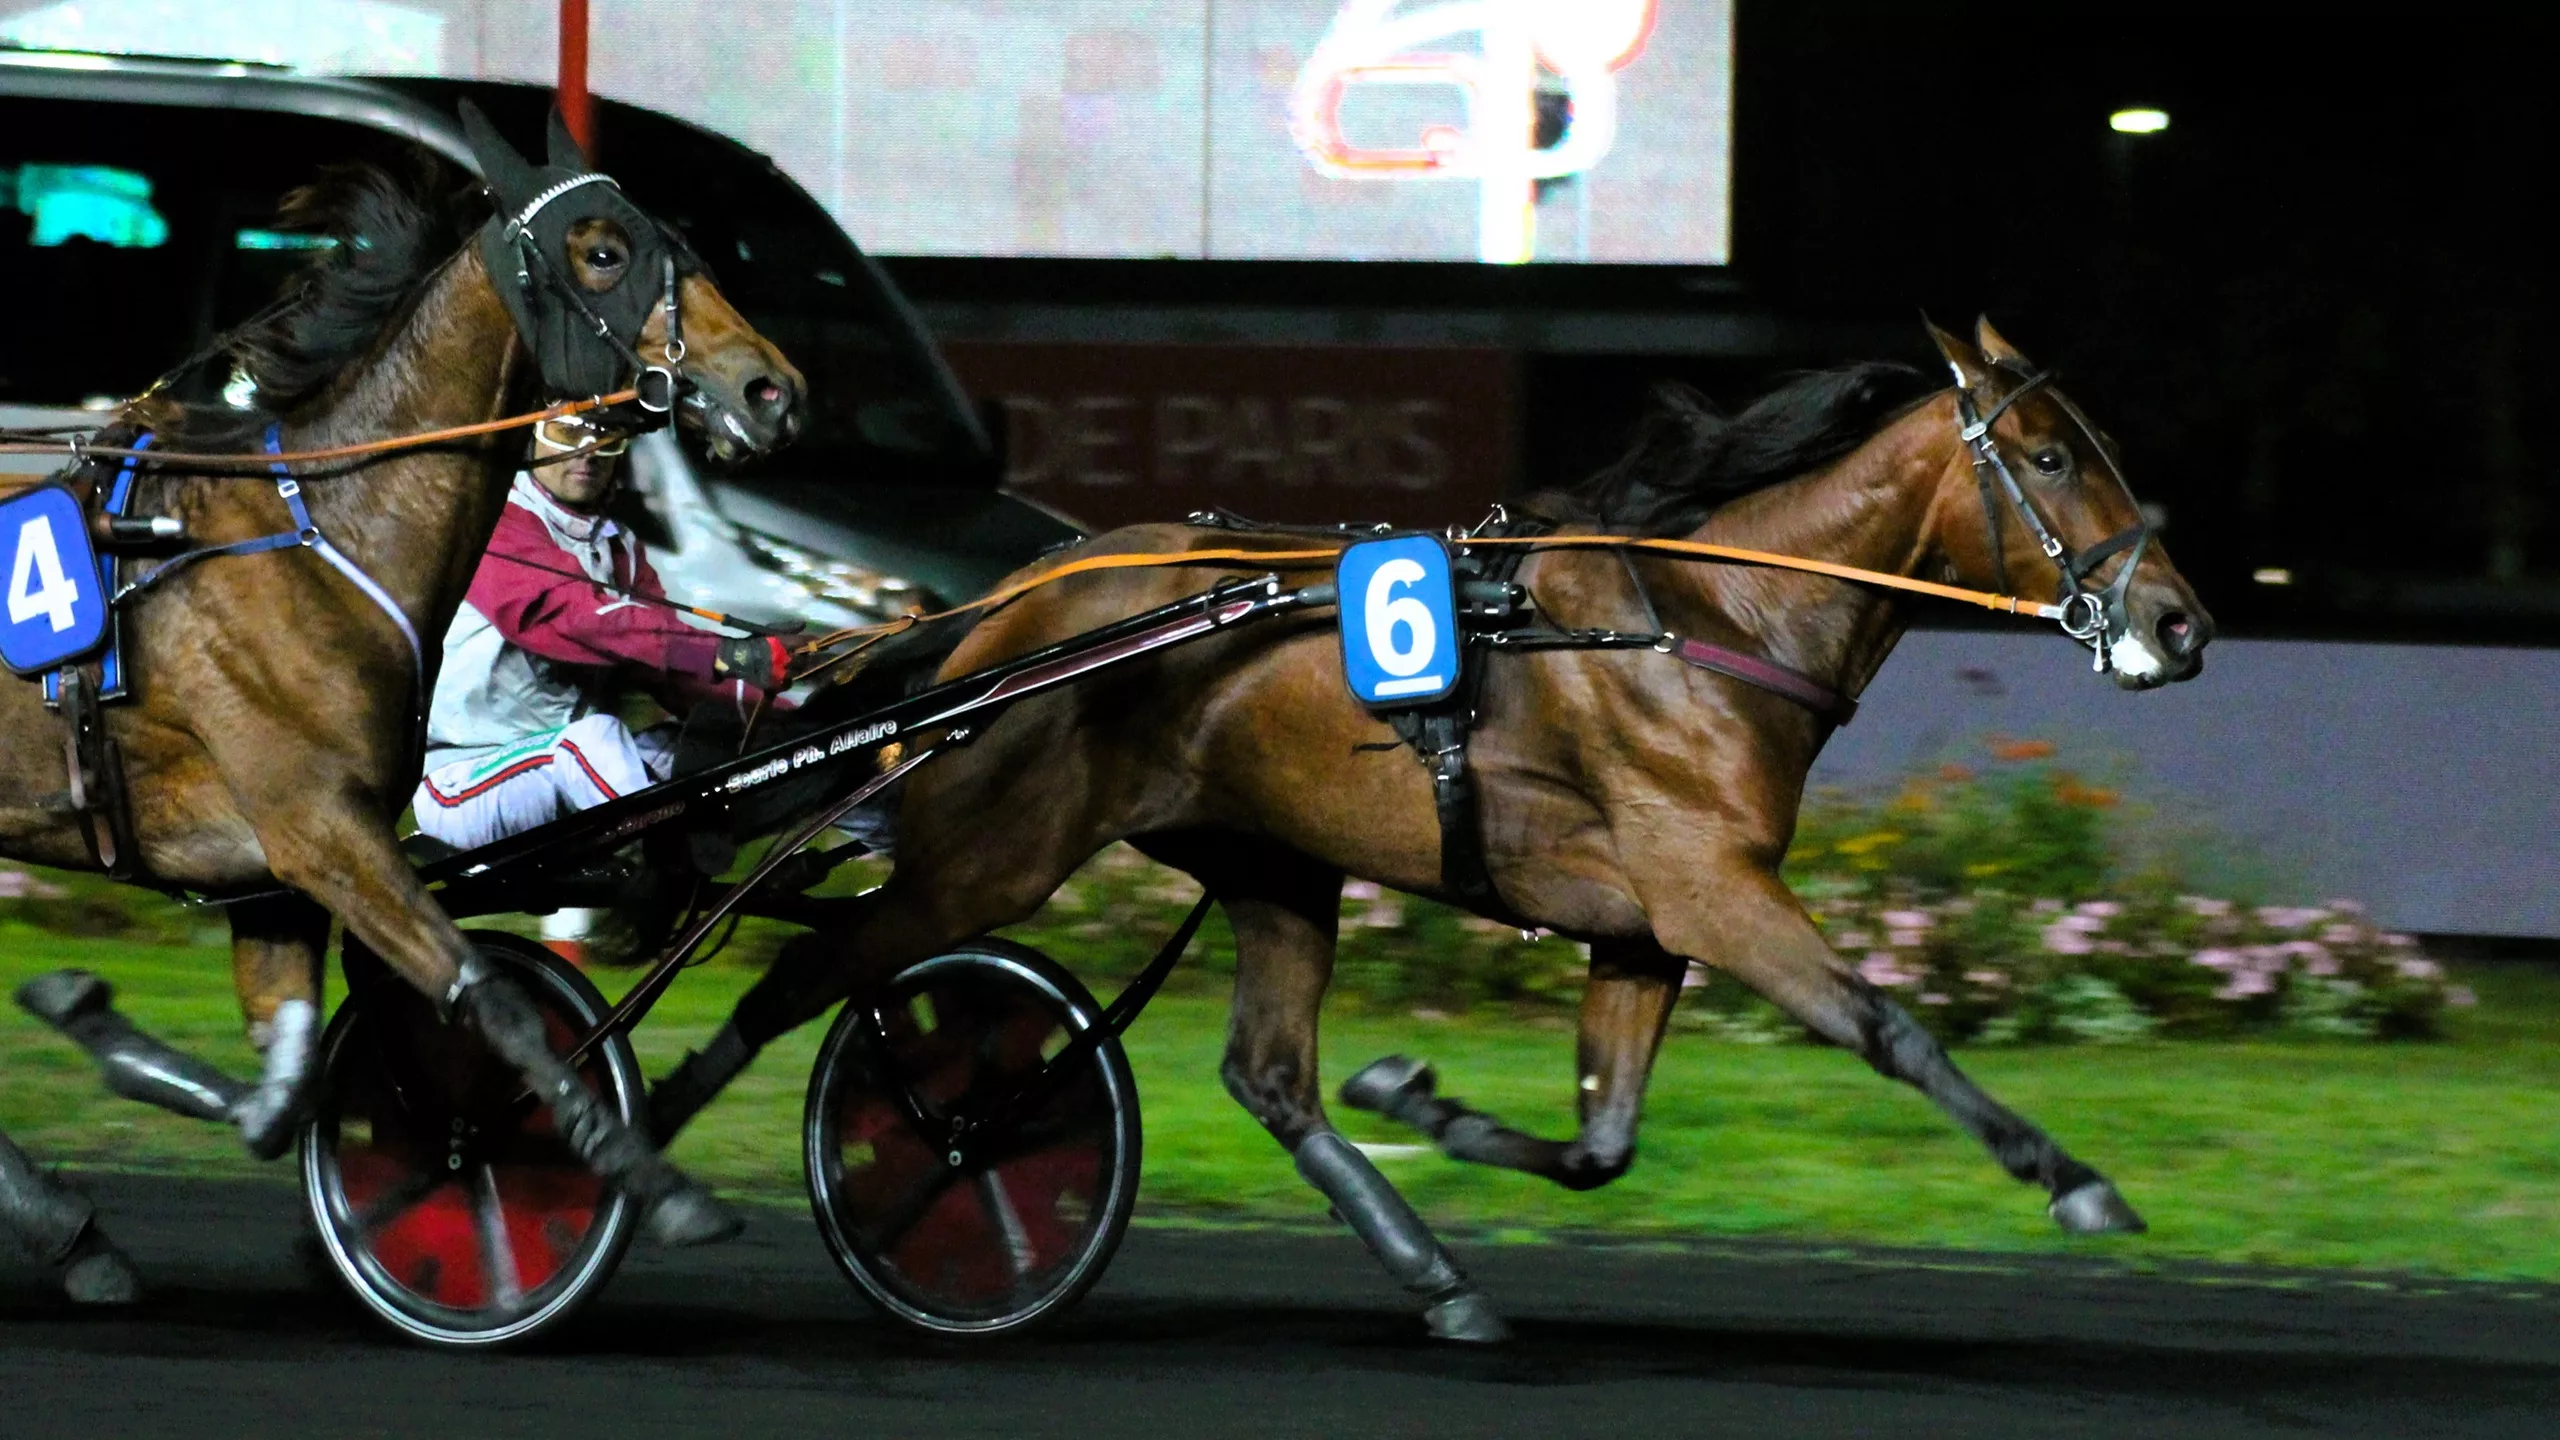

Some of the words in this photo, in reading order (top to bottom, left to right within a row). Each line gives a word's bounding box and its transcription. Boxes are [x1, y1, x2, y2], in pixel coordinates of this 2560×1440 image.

[1002, 396, 1137, 487] DE
[1155, 397, 1450, 490] PARIS
[7, 514, 79, 633] 4
[1364, 558, 1436, 677] 6
